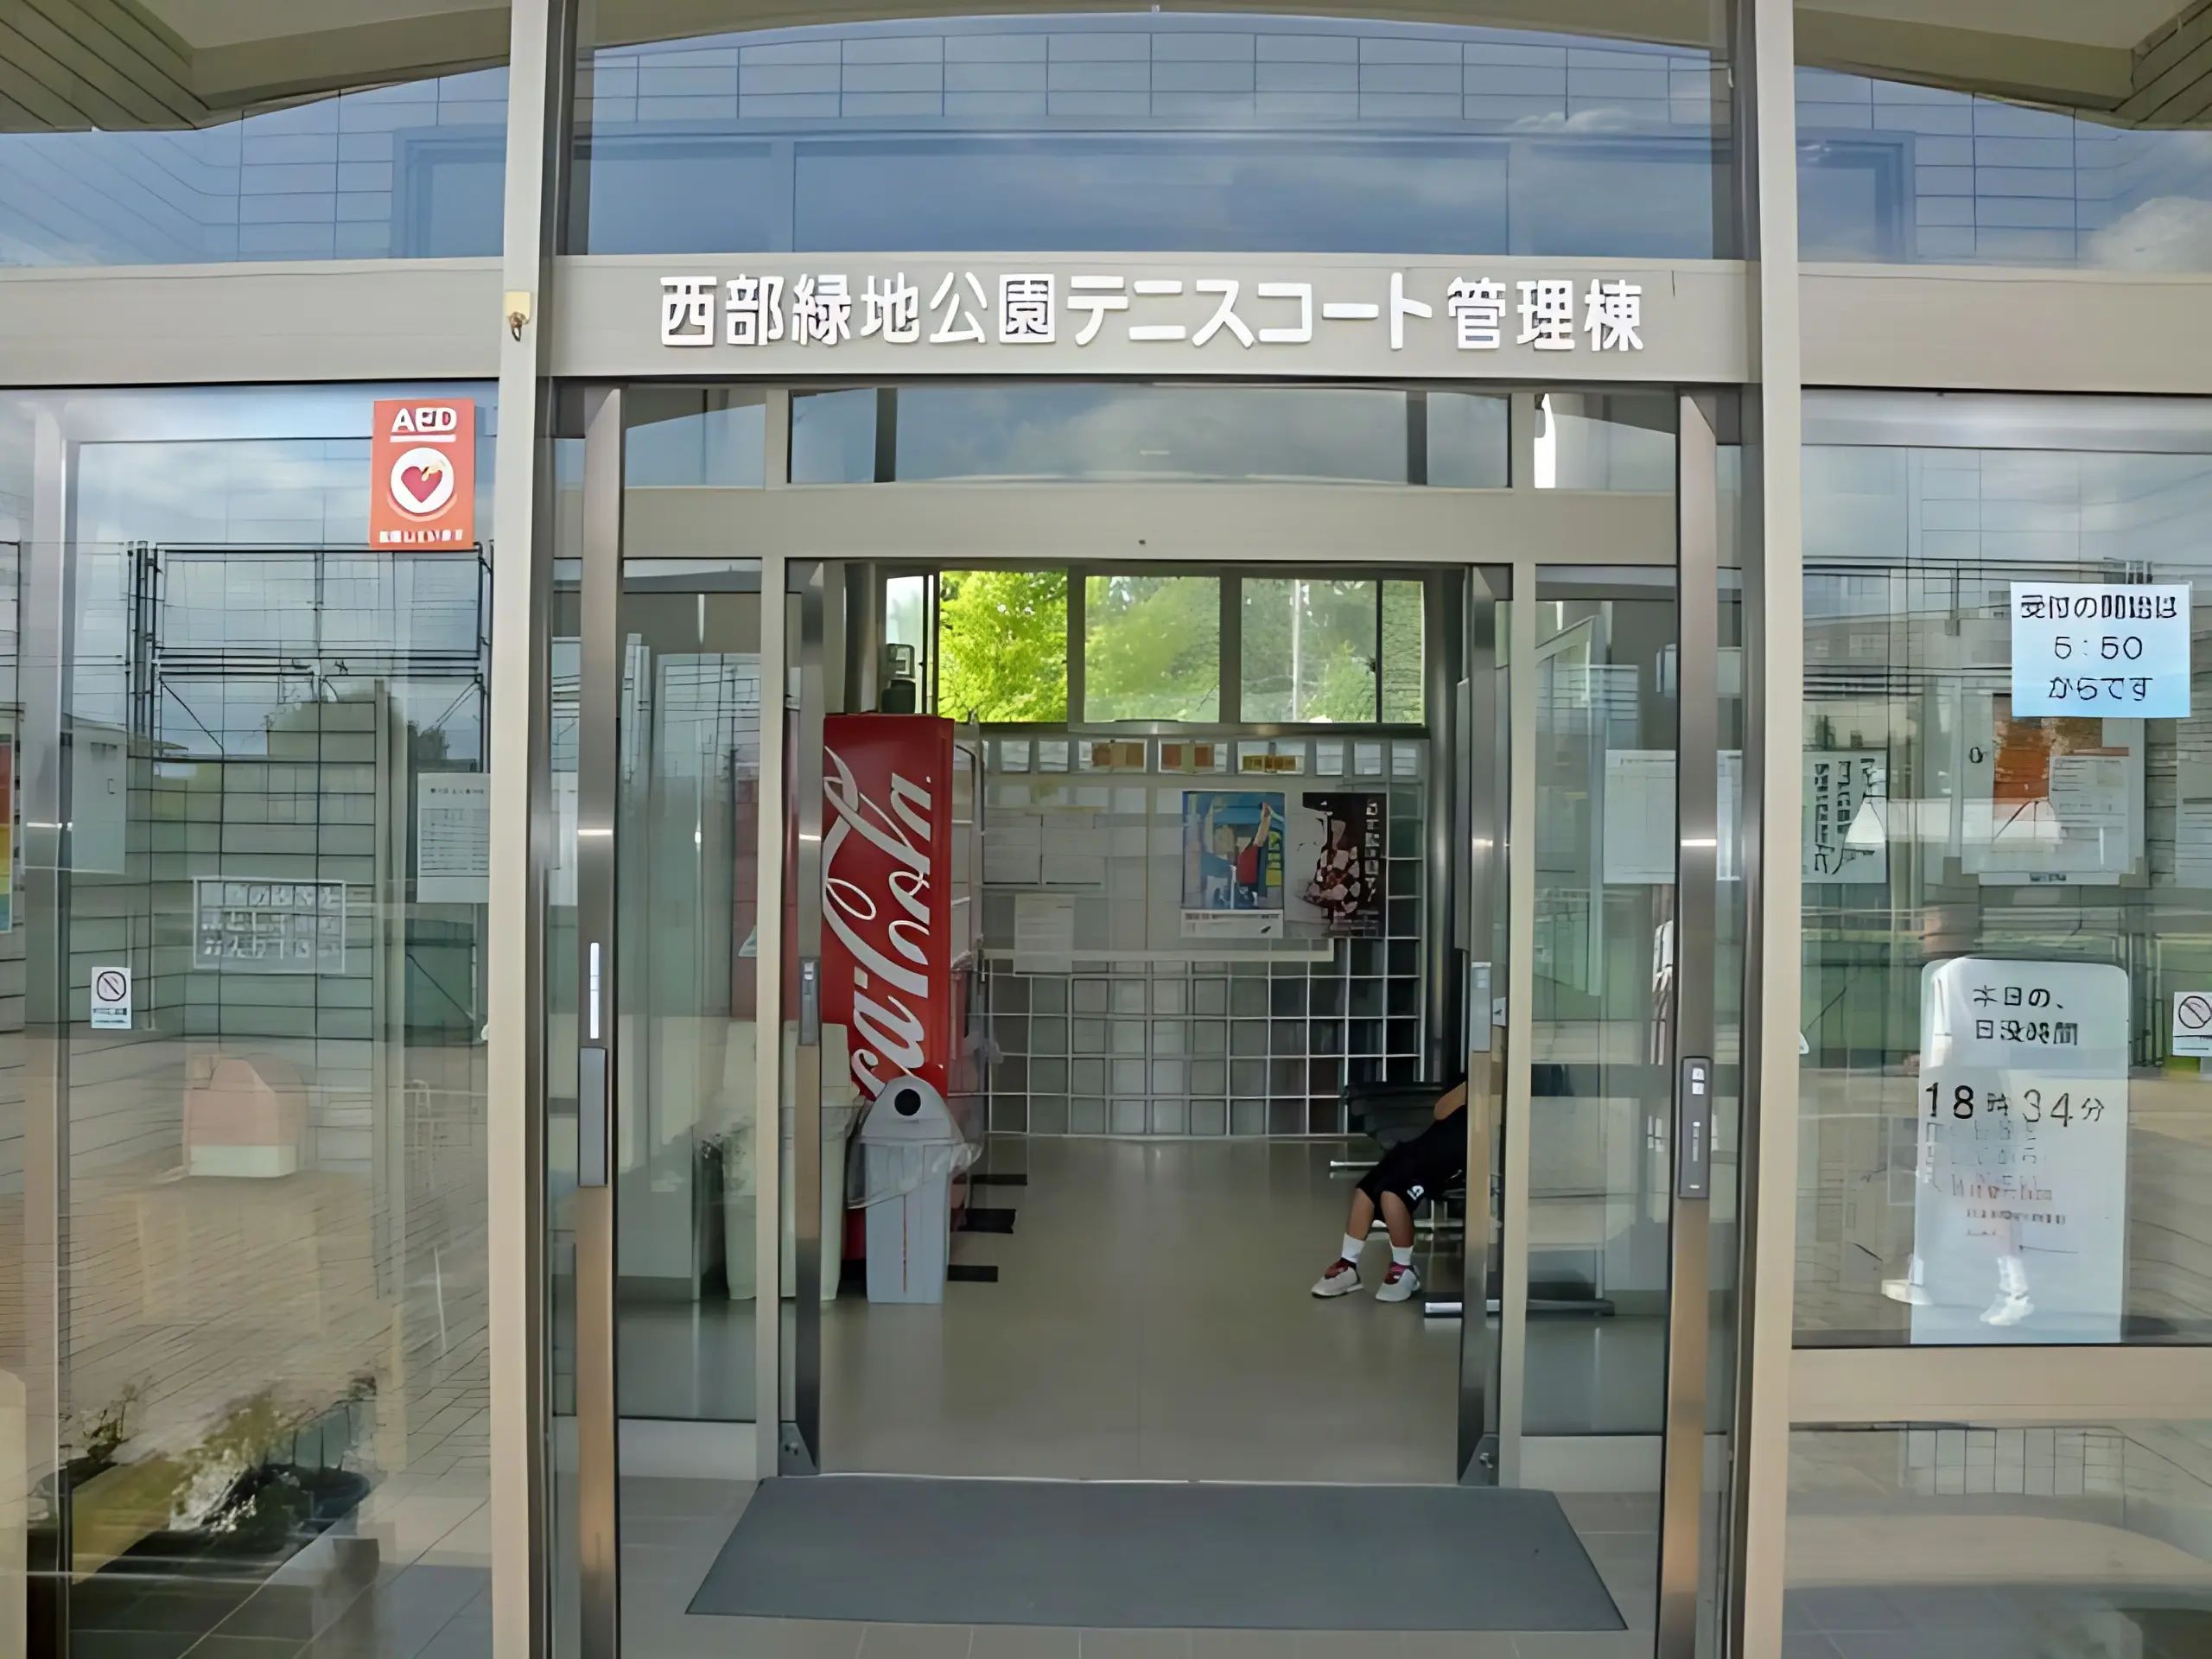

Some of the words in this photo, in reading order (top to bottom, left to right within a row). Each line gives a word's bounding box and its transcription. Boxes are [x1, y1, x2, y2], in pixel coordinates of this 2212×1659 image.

[660, 272, 1643, 351] 西部緑地公園テニスコート管理棟
[391, 407, 457, 432] AED
[2048, 677, 2153, 701] からです
